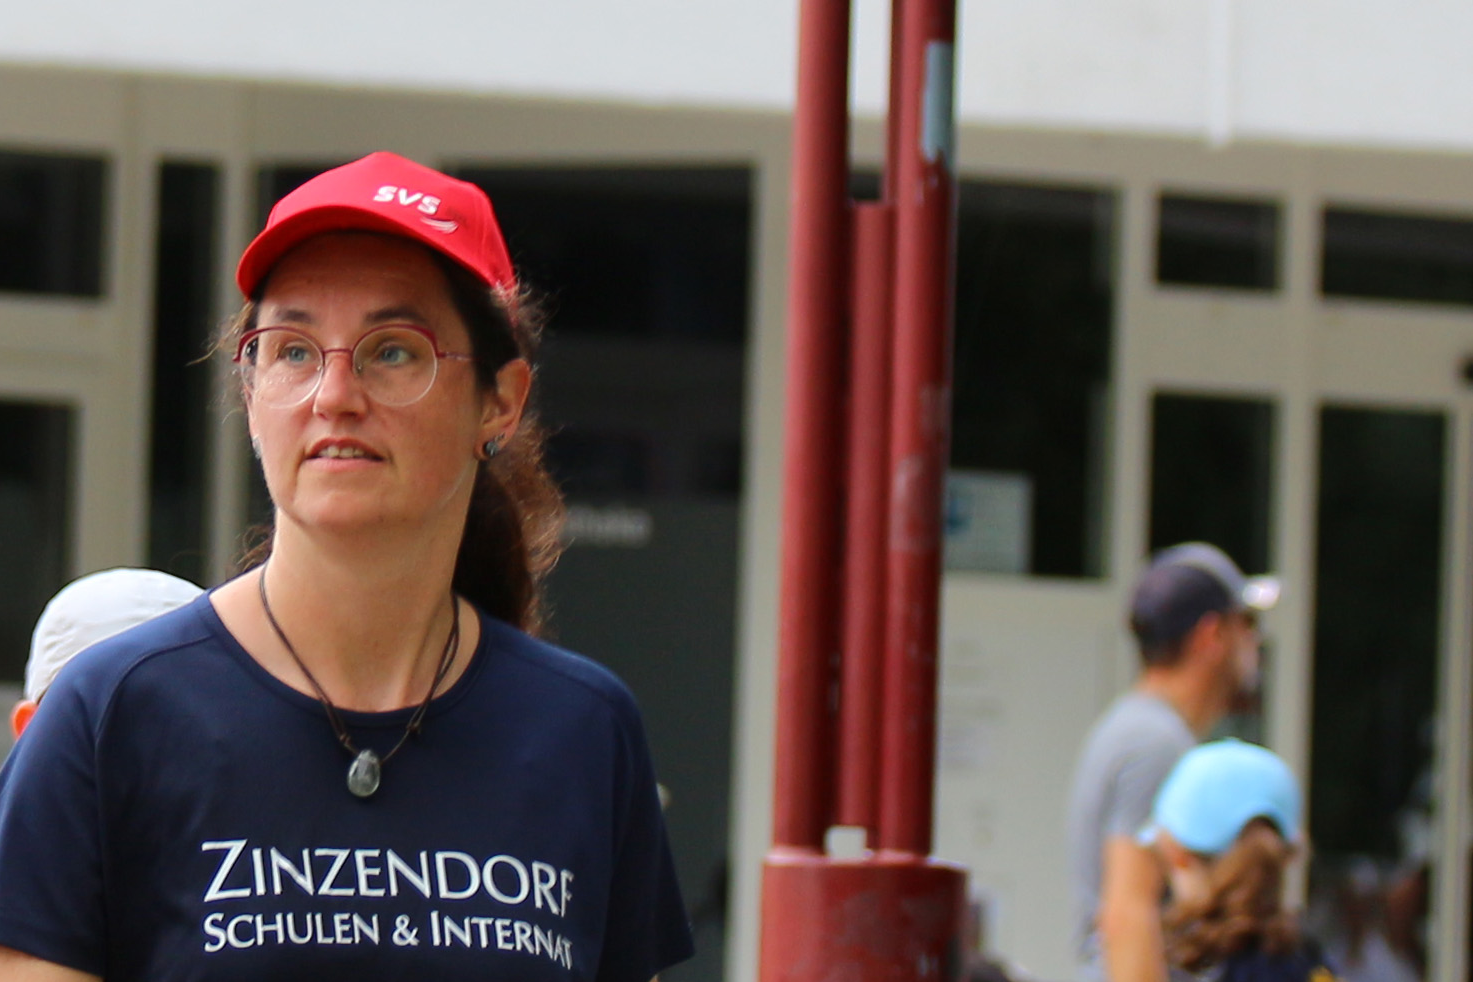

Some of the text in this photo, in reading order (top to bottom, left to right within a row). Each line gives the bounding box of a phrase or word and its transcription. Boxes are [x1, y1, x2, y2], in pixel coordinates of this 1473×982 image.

[373, 185, 442, 215] SVS
[201, 838, 575, 918] ZINZENDORF
[203, 910, 574, 970] SCHULEN & INTERNAT
